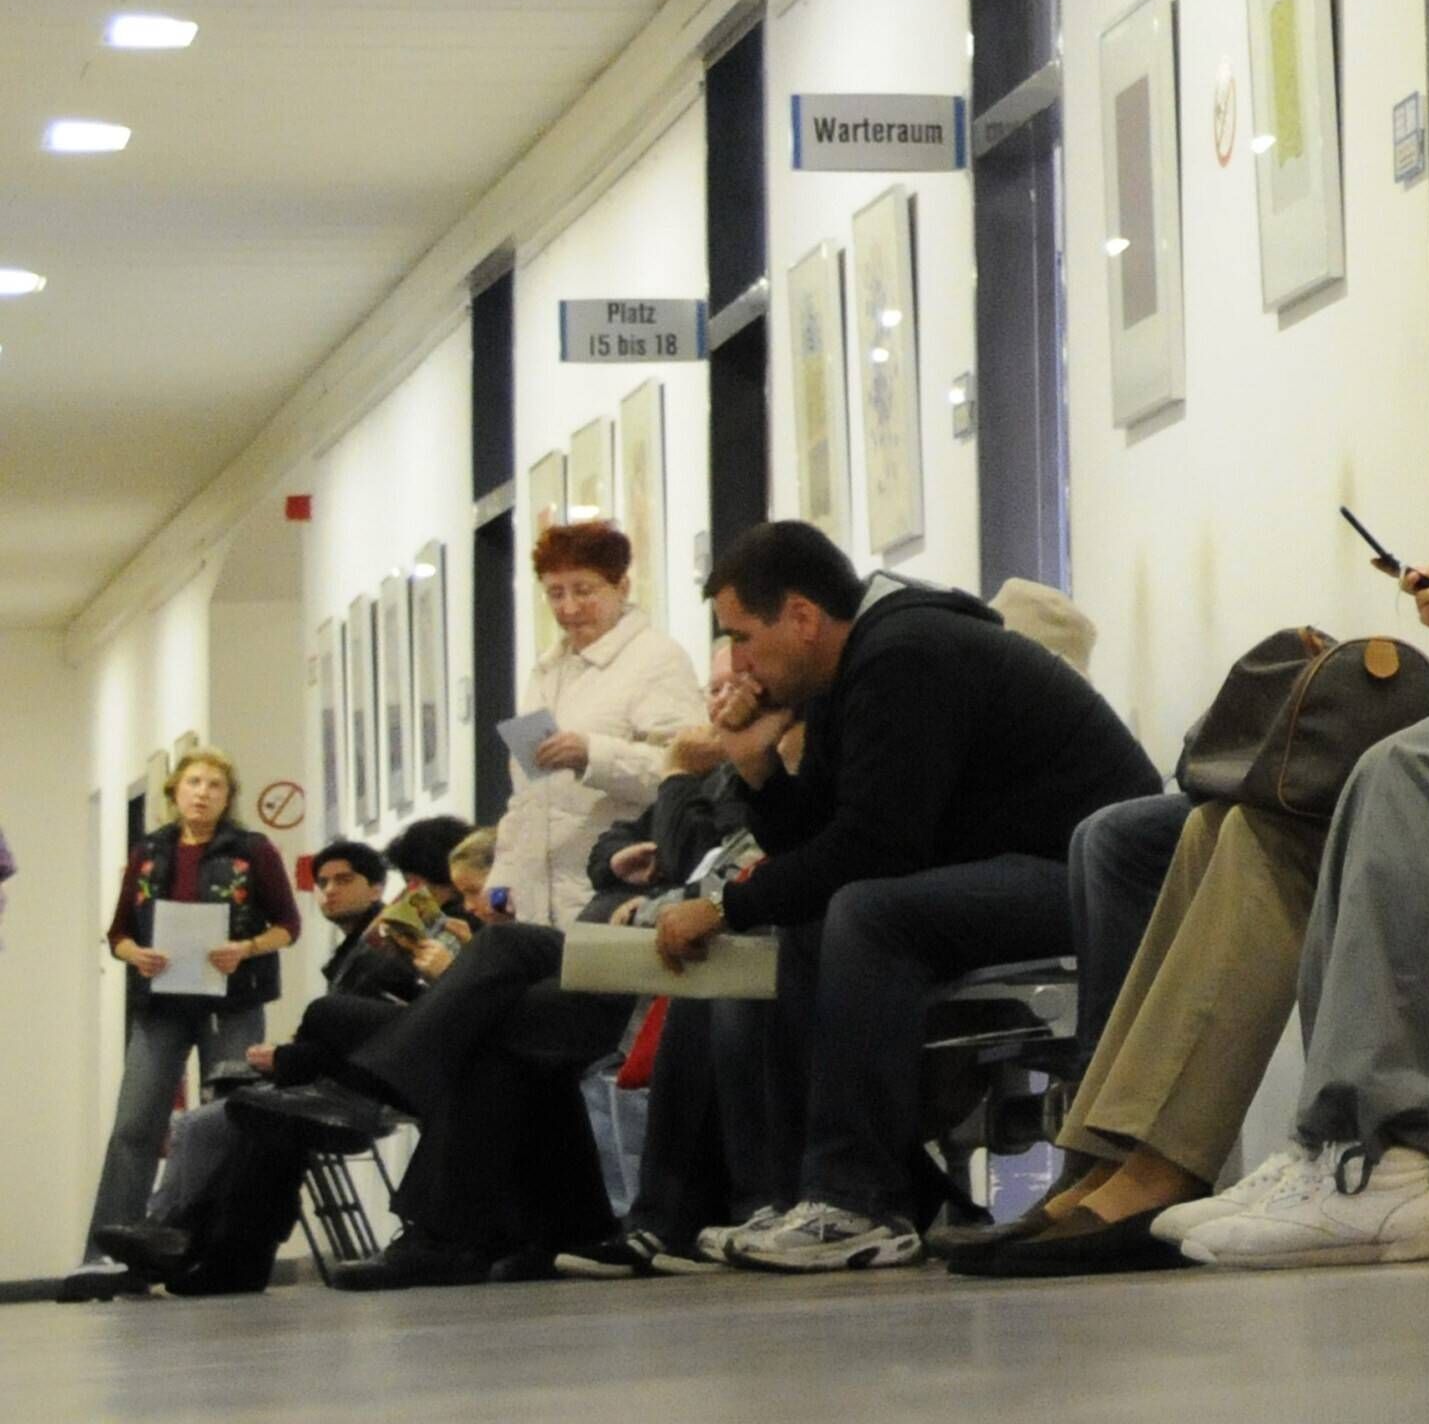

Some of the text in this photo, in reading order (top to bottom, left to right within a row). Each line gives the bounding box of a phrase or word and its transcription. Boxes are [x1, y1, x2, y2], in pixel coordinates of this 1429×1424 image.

[813, 117, 944, 144] Warteraum
[607, 302, 657, 324] Platz
[589, 333, 678, 356] 15 bis 18
